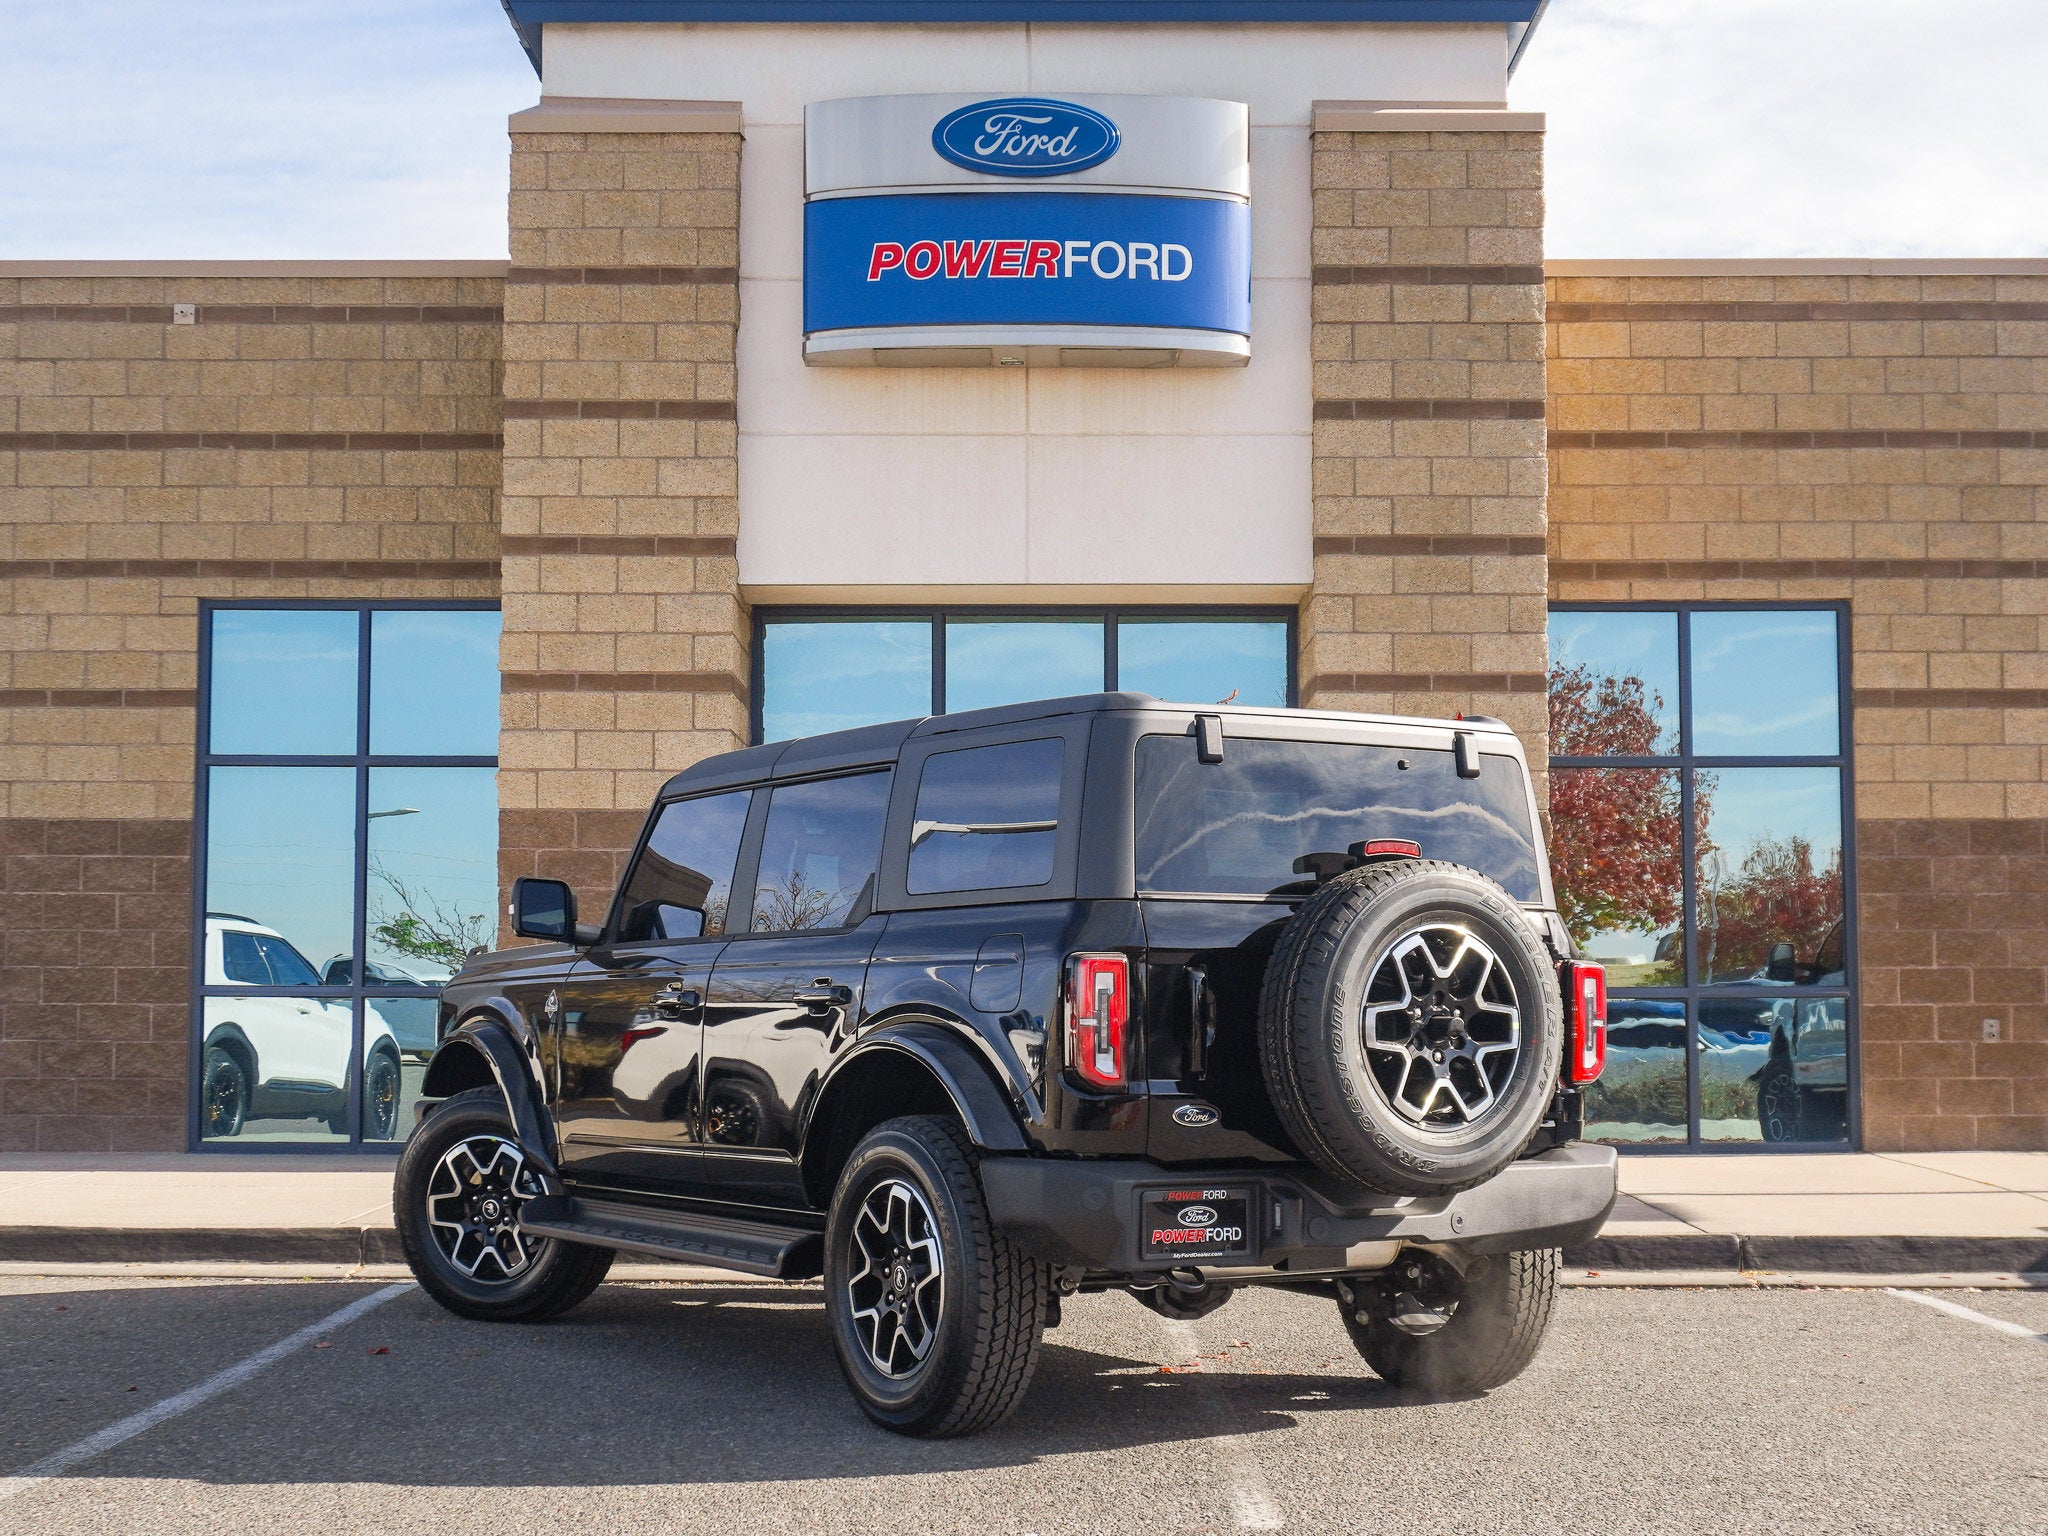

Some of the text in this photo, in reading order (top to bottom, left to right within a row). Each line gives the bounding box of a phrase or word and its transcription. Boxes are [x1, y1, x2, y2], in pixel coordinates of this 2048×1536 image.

[974, 113, 1079, 157] Ford
[1331, 982, 1440, 1173] BRIDGESTONE
[1184, 1109, 1210, 1122] Ford
[1185, 1209, 1209, 1222] Ford
[1172, 1251, 1223, 1260] MyFordDealer.com
